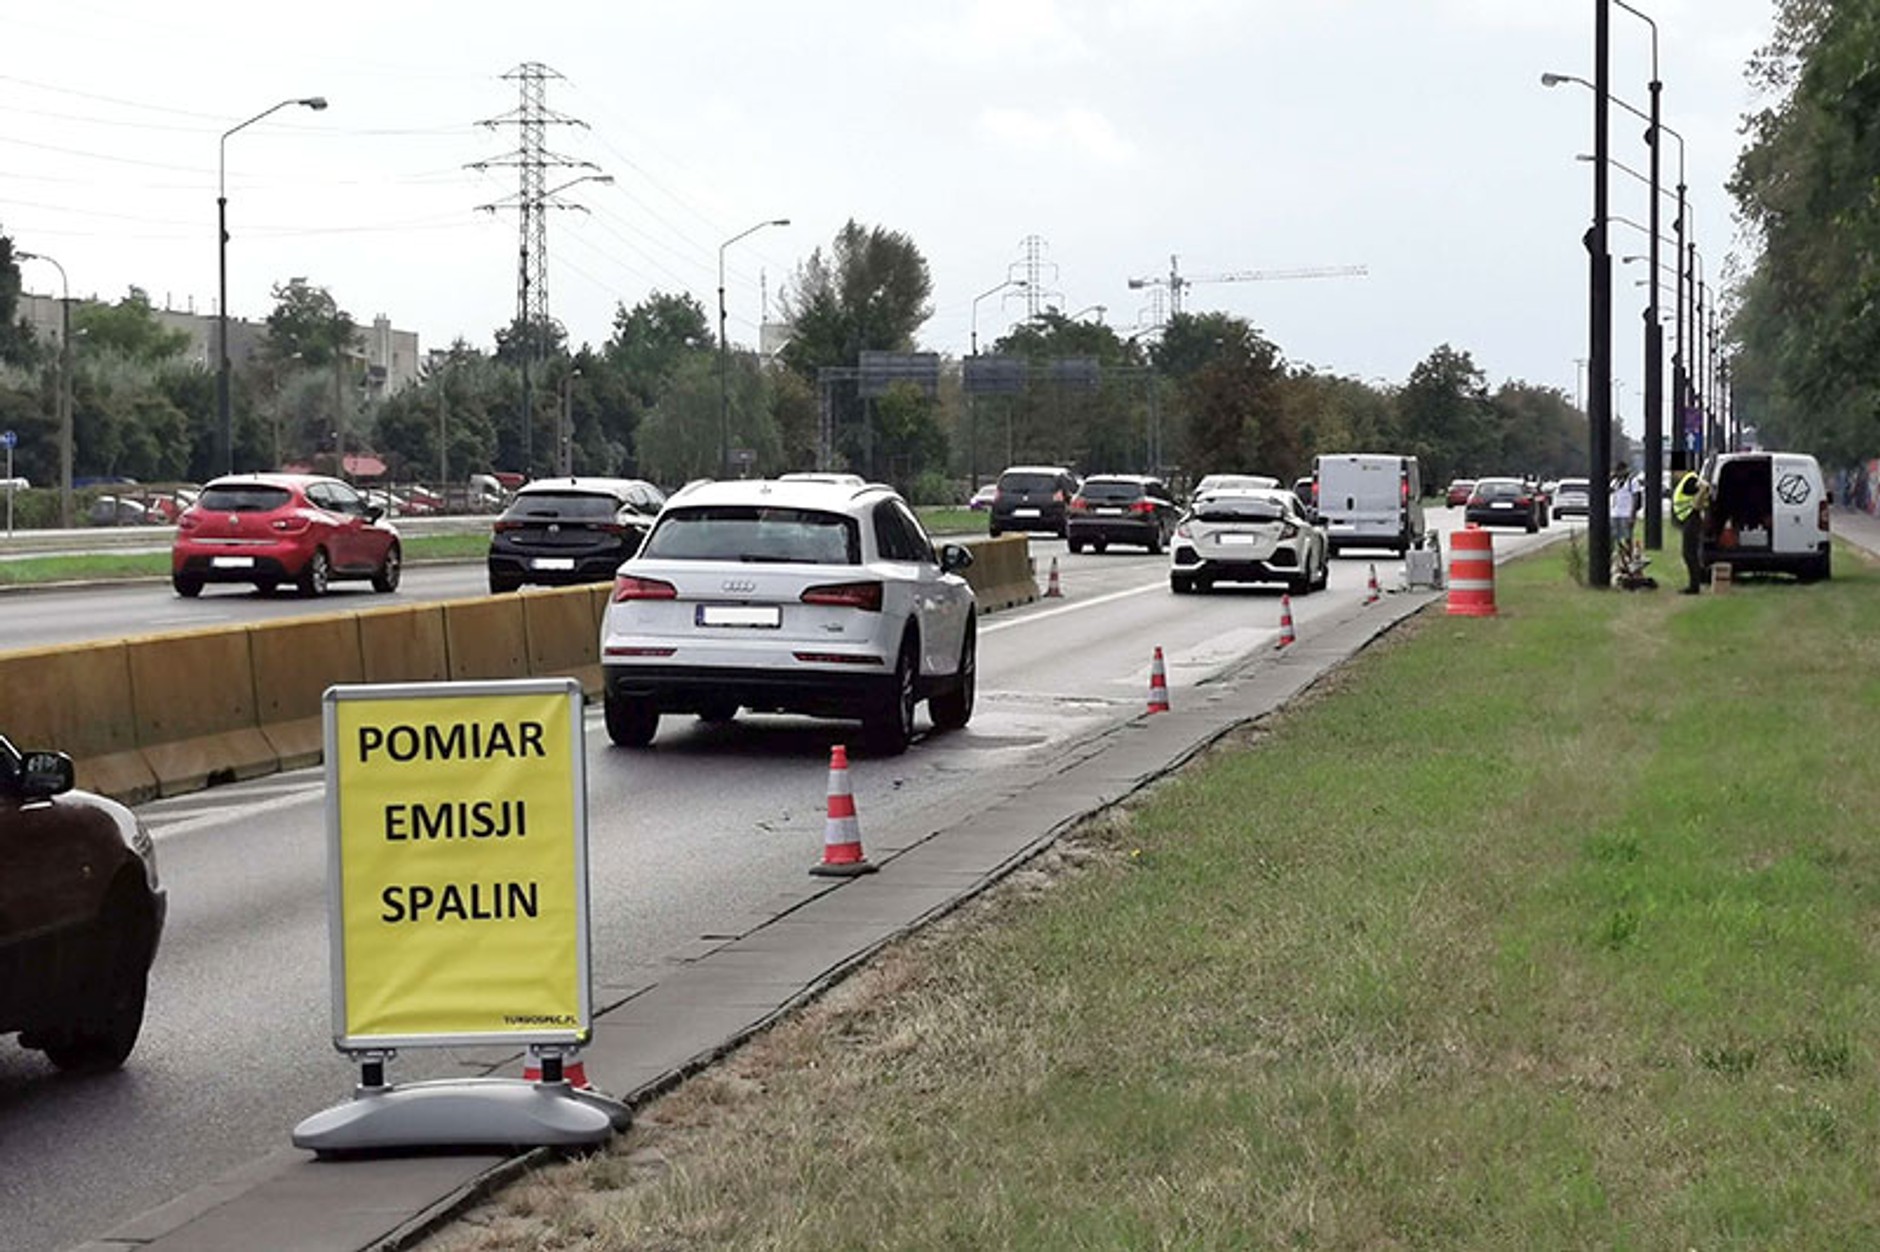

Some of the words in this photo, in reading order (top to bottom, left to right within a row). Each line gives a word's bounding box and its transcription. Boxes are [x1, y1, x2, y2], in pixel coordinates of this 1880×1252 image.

[359, 721, 546, 762] POMIAR
[385, 800, 526, 841] EMISJI
[382, 882, 538, 923] SPALIN
